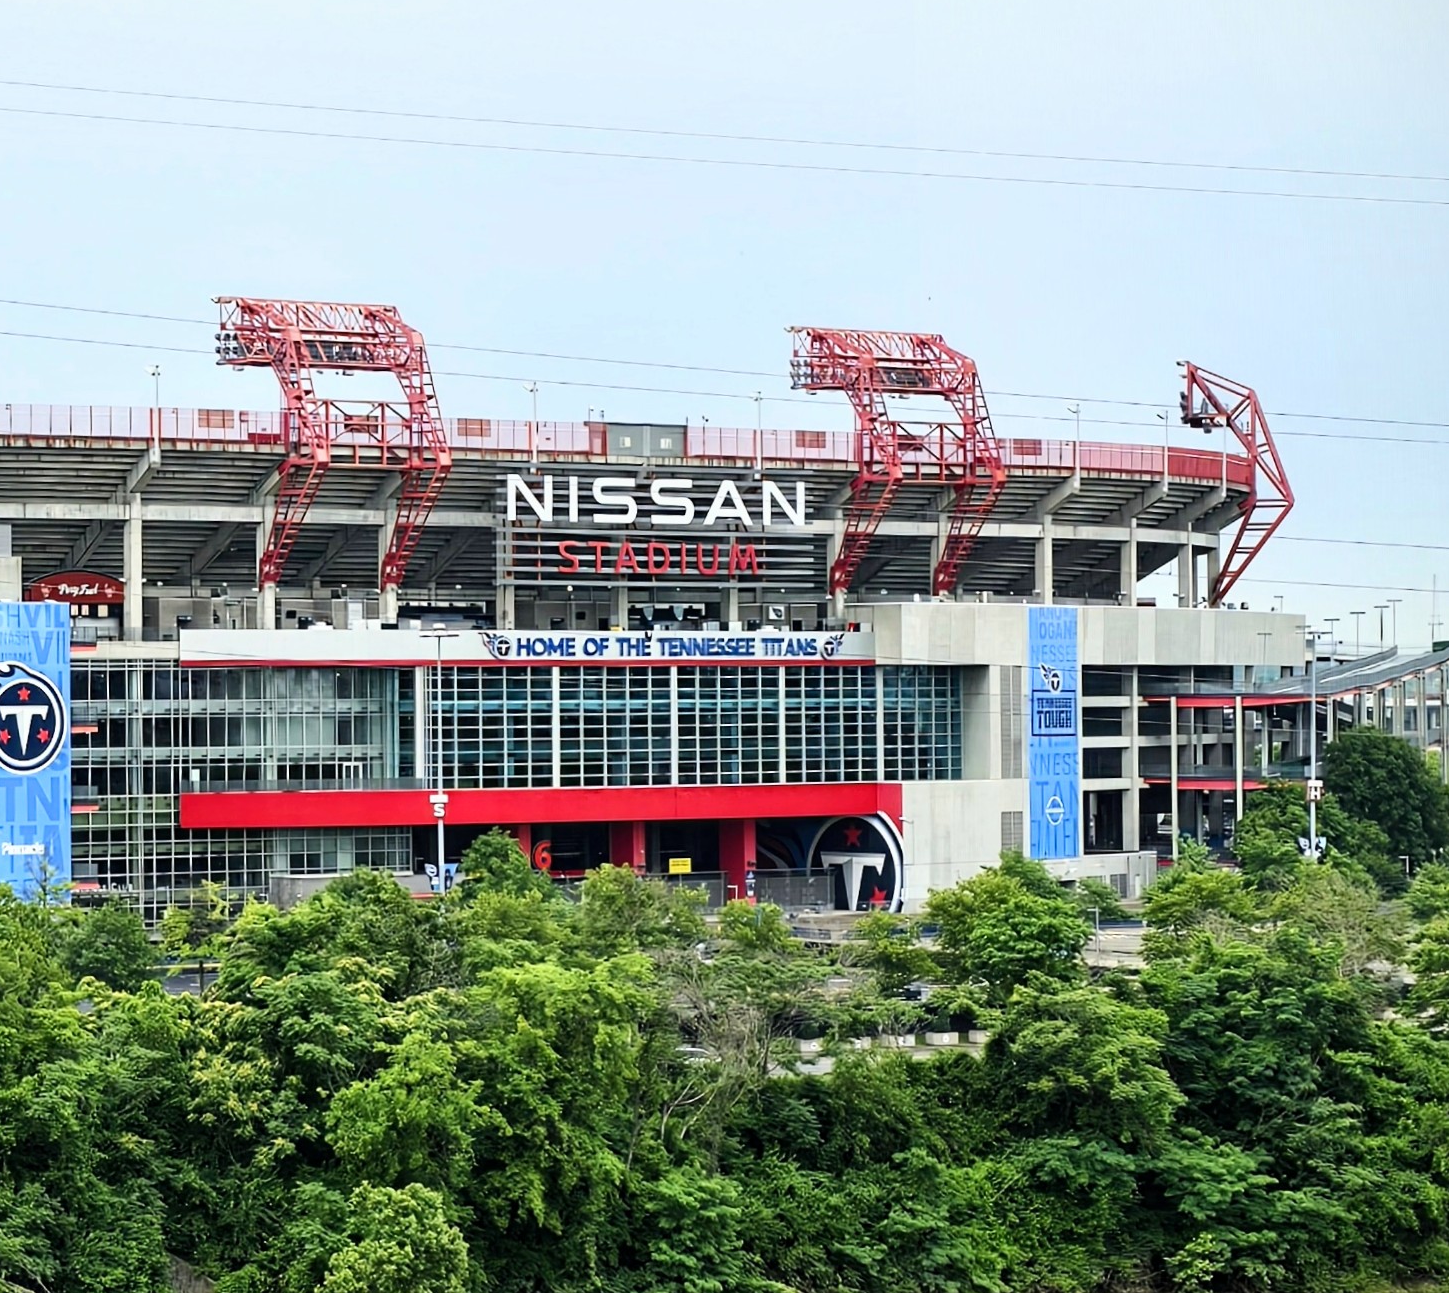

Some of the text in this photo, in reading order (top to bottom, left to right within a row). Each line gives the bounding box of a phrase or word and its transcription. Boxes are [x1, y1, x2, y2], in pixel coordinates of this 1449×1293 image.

[507, 473, 806, 526] NISSAN
[558, 540, 758, 575] STADIUM
[517, 637, 575, 656] HOME
[583, 637, 609, 656] OF
[616, 637, 652, 656] THE
[657, 637, 755, 656] TENNESSEE
[761, 637, 817, 656] TITANS
[1036, 710, 1072, 729] TOUGH
[433, 804, 446, 817] S
